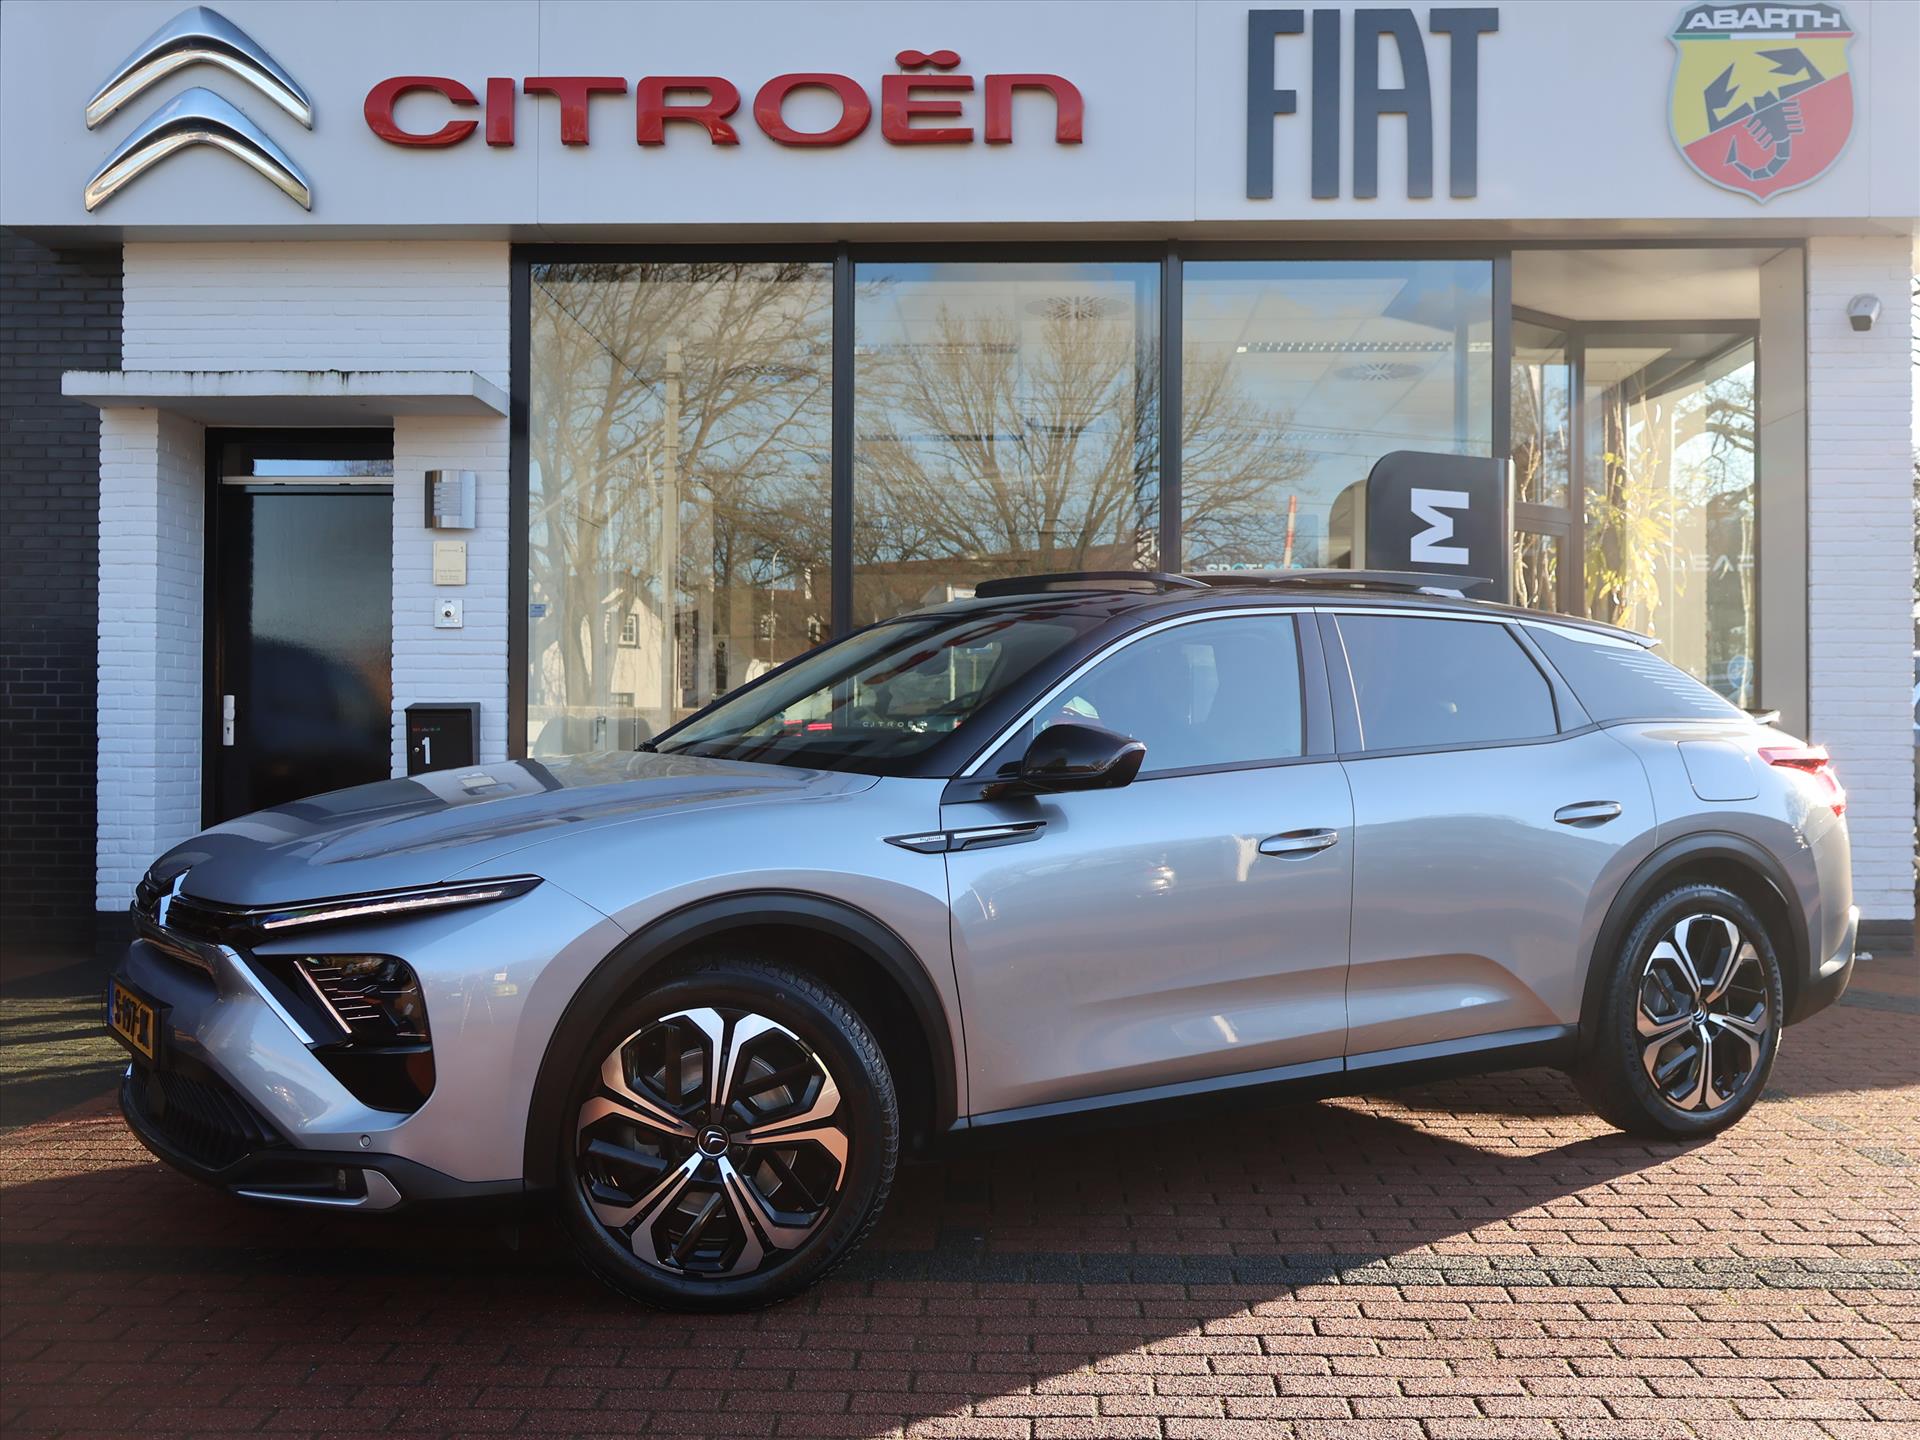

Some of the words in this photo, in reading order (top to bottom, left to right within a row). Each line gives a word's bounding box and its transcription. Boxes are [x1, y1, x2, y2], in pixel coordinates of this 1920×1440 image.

[1686, 8, 1841, 30] ABARTH
[1246, 8, 1499, 200] FIAT
[1410, 488, 1470, 566] M
[421, 736, 431, 765] 1
